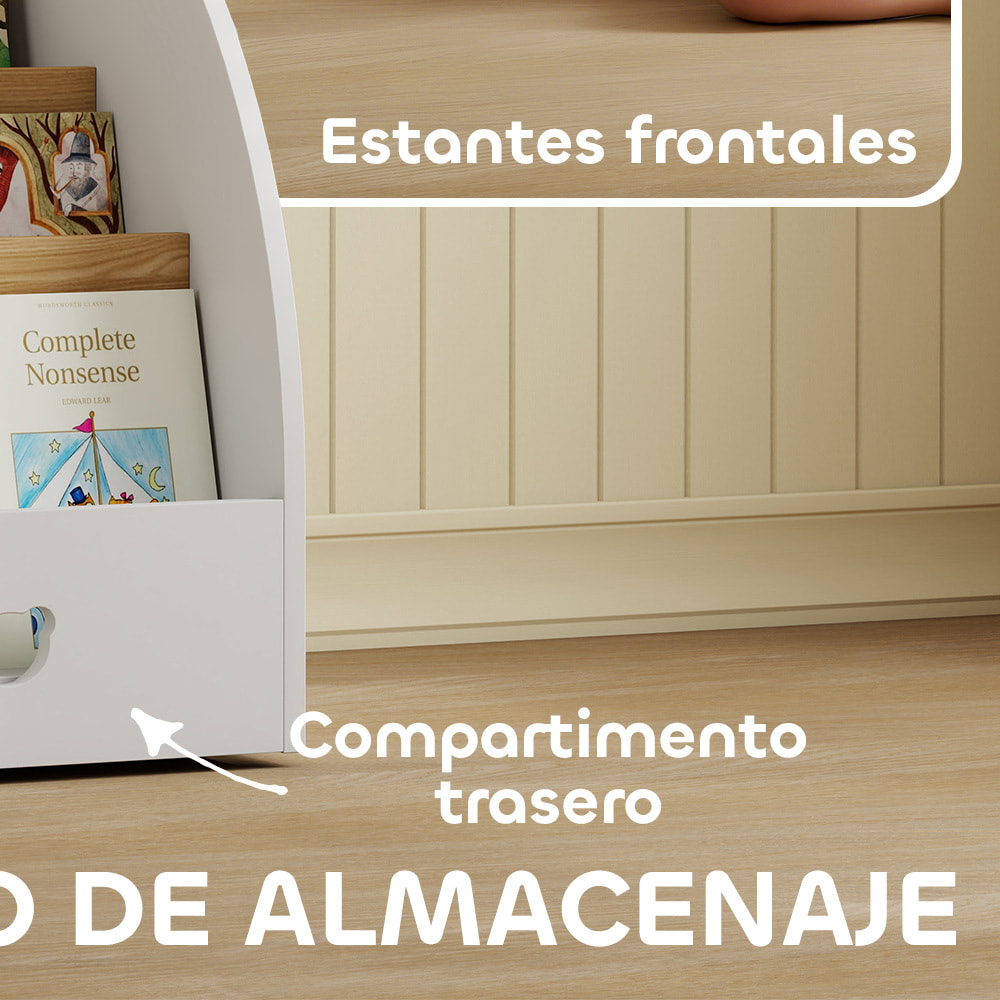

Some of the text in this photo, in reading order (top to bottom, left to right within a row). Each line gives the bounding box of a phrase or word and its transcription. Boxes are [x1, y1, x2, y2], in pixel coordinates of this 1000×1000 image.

[22, 327, 136, 358] Complete
[26, 361, 140, 386] Nonsense
[62, 396, 112, 406] EDWARD LEAR
